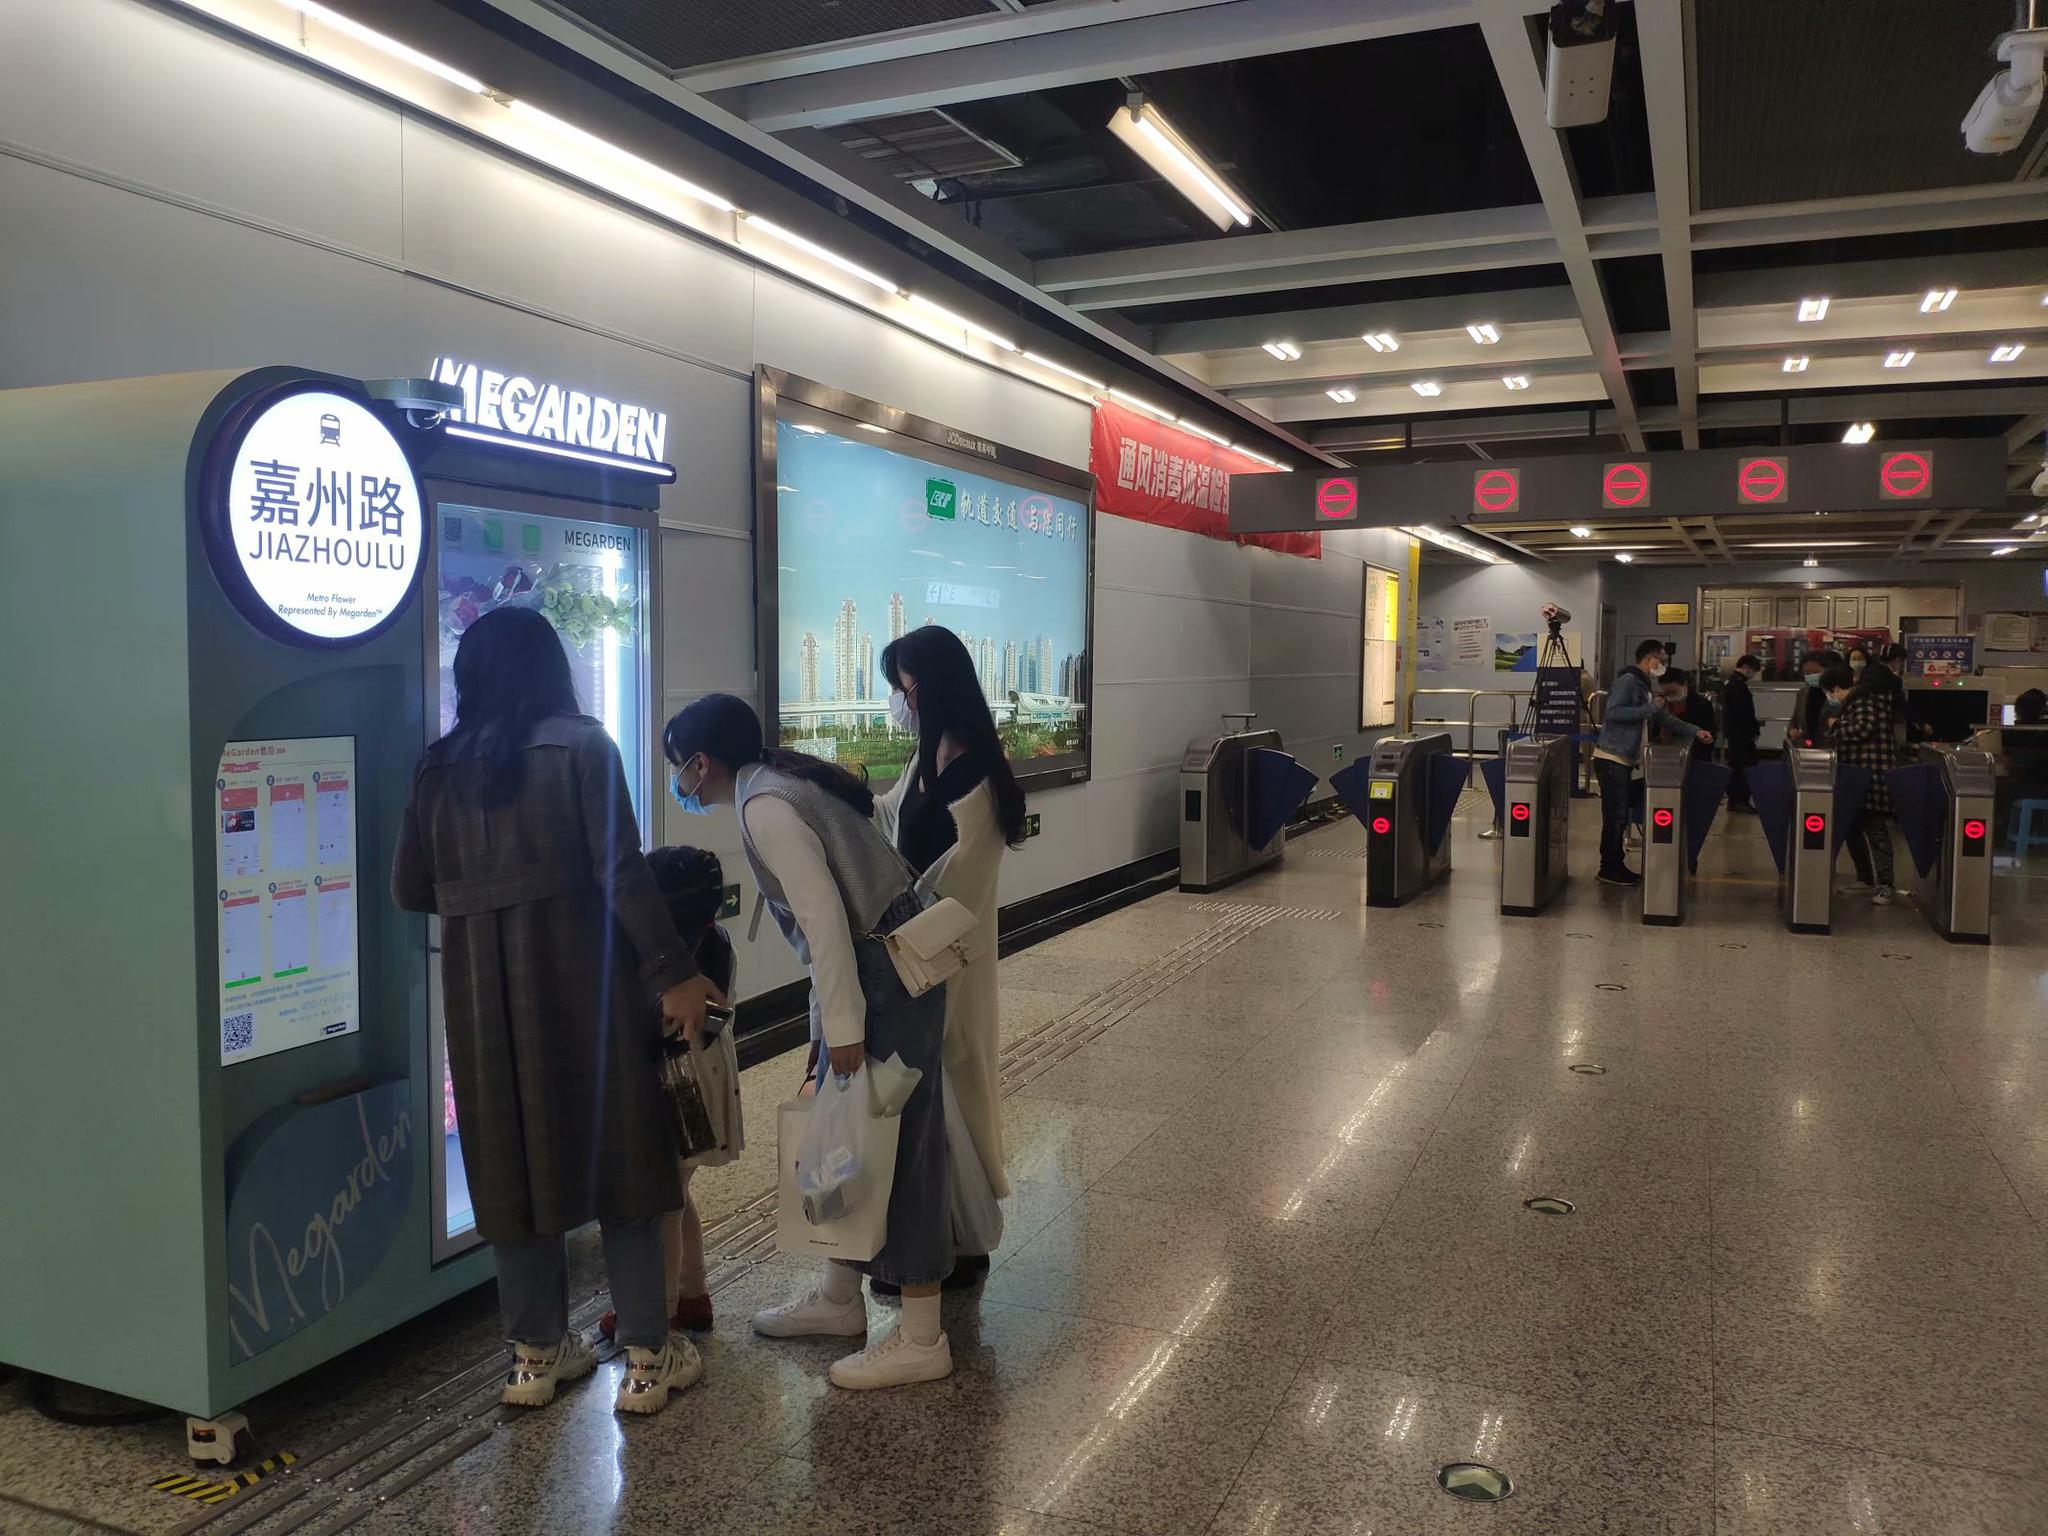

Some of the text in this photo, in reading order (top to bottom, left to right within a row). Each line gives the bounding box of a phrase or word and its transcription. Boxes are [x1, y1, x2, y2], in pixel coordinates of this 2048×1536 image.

[249, 458, 405, 538] 嘉州路
[960, 488, 1019, 533] 轨道交通
[248, 530, 406, 571] JIAZHOULU
[564, 529, 631, 552] MEGARDEN
[278, 604, 326, 617] Represented
[327, 607, 337, 618] By
[307, 593, 330, 602] Metro
